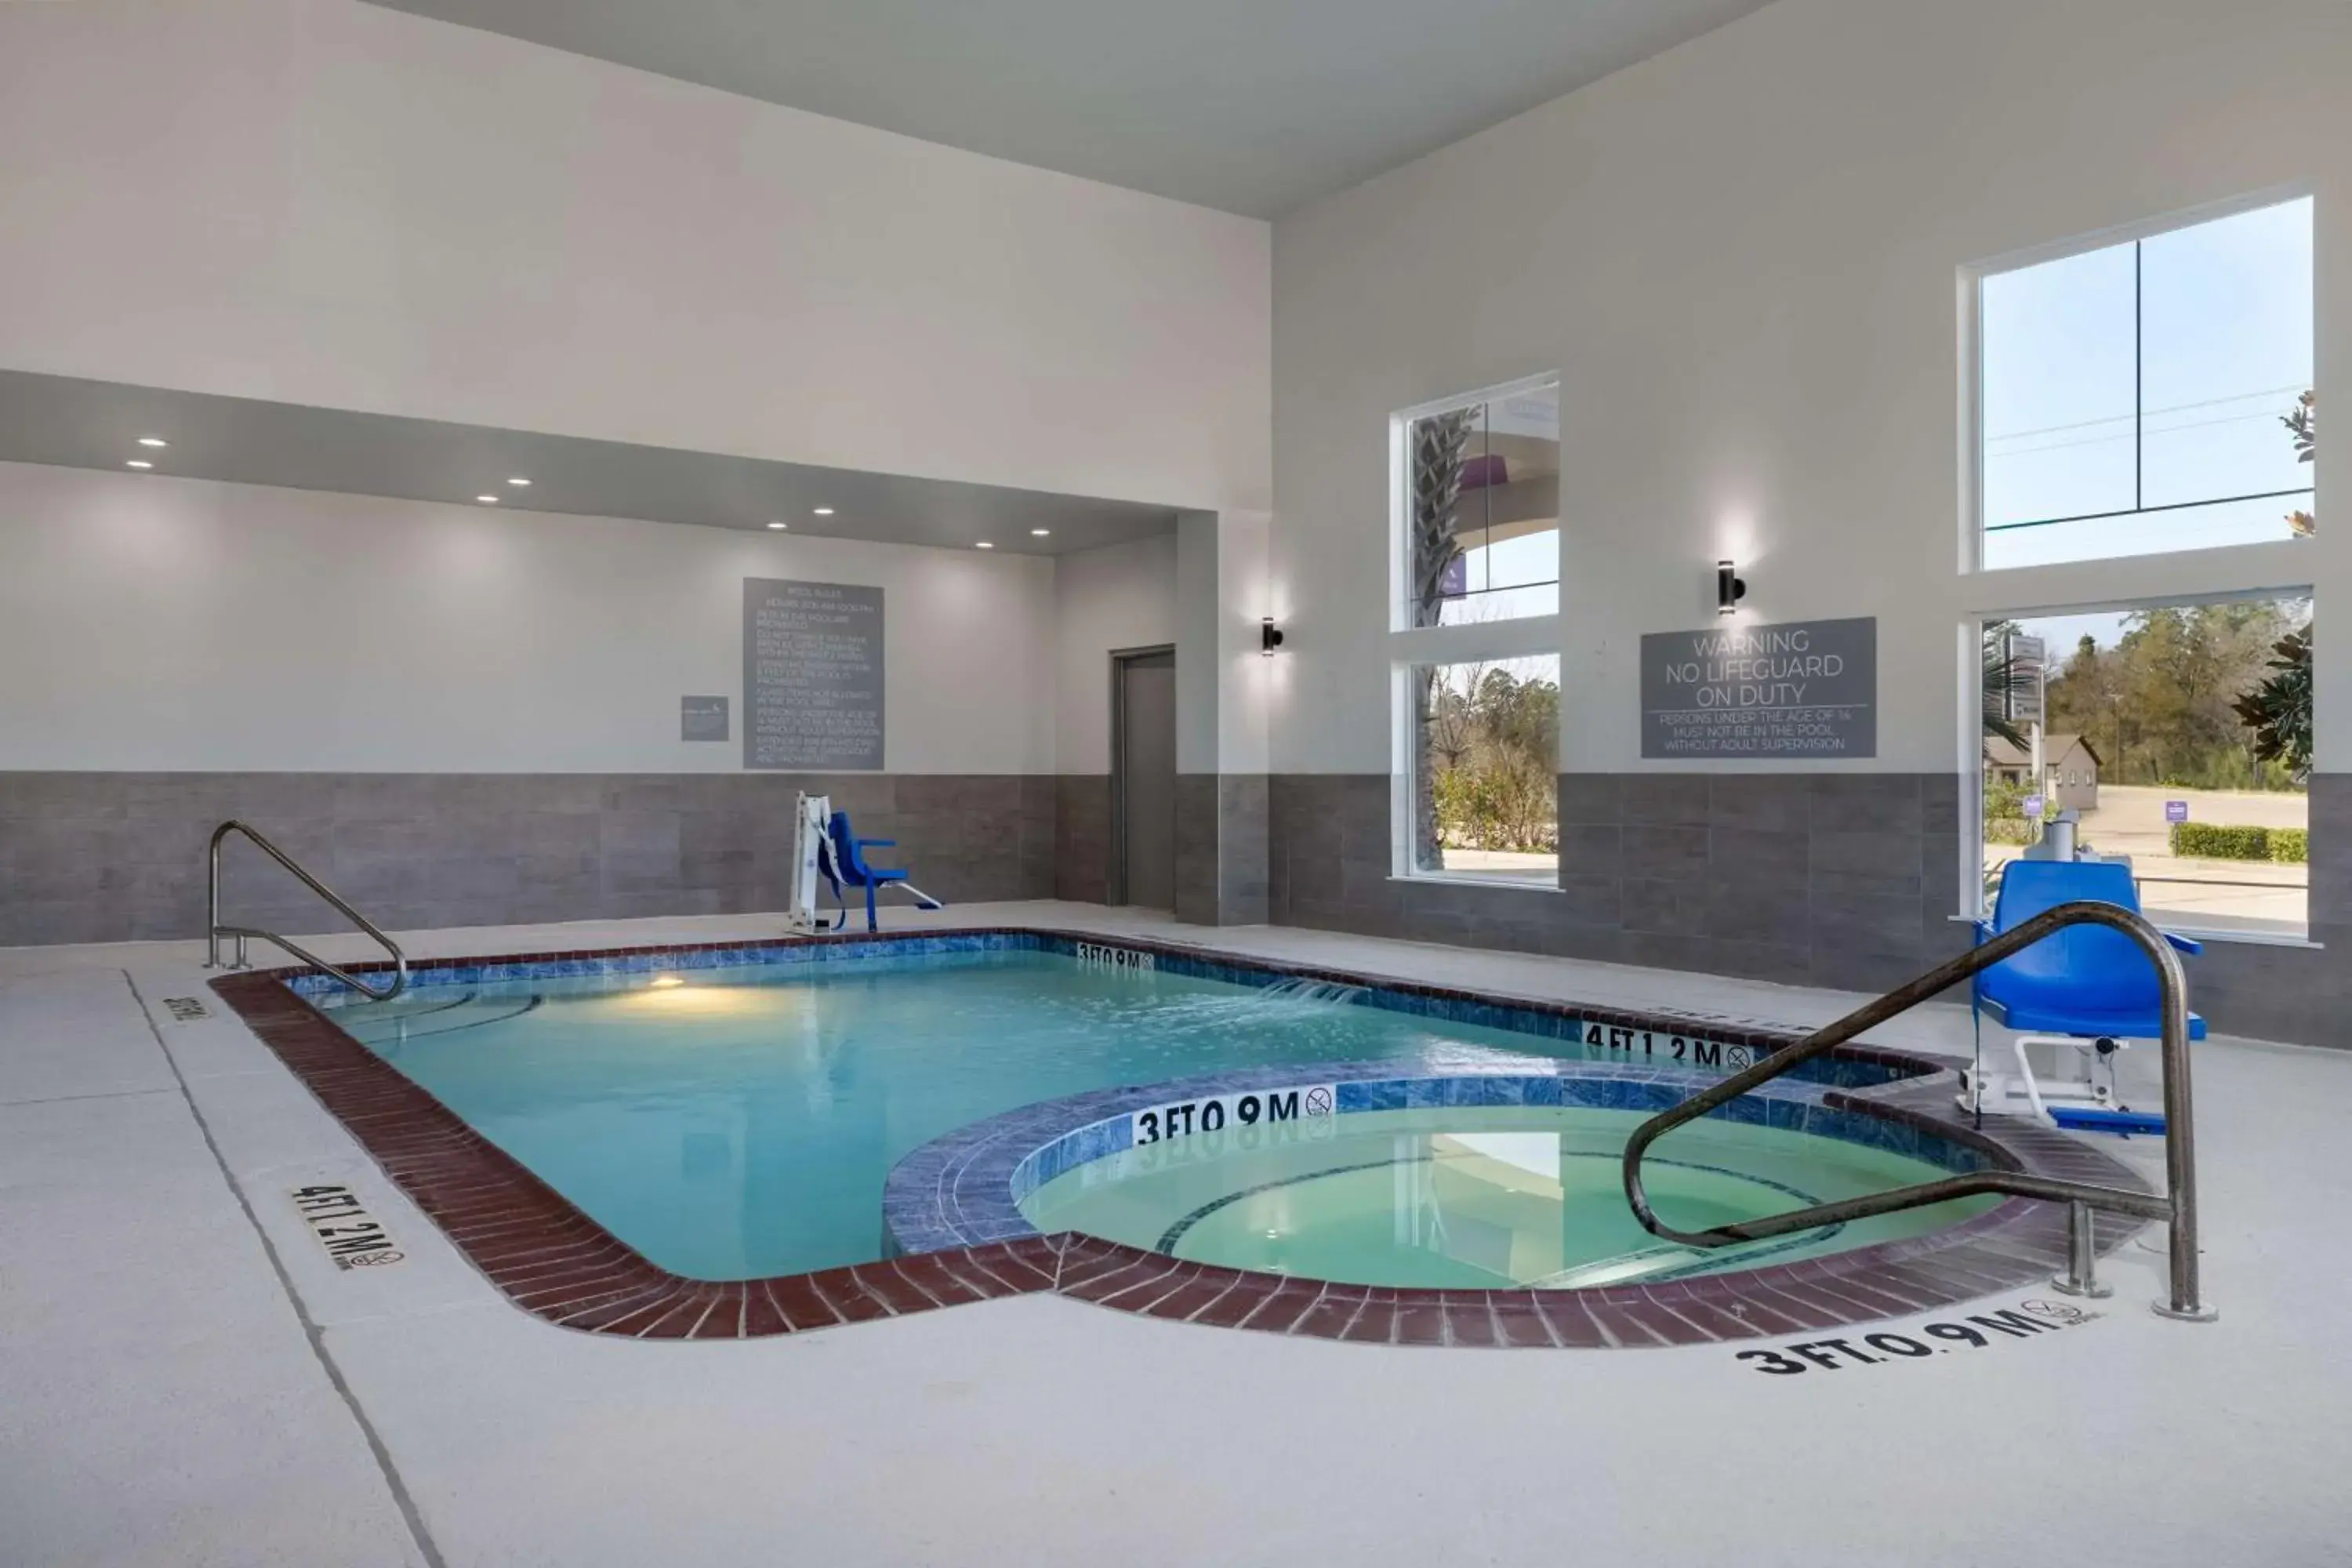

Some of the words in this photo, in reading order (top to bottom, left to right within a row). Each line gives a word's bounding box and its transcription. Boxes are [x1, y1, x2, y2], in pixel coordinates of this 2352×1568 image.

[1693, 630, 1809, 657] WARNING
[1665, 662, 1700, 684] NO
[1707, 655, 1843, 682] LIFEGUARD
[1697, 687, 1731, 707] ON
[1740, 683, 1806, 706] DUTY
[1660, 713, 1711, 726] PERSONS
[1714, 712, 1756, 724] UNDER
[1759, 710, 1783, 722] THE
[1787, 710, 1813, 721] AGE
[1817, 709, 1834, 720] OF
[1674, 726, 1703, 738] MUST
[1708, 725, 1732, 737] NOT
[1735, 724, 1751, 737] BE
[1754, 724, 1766, 736] IN
[1771, 724, 1794, 736] THE
[1664, 739, 1718, 752] WITHOUT
[1719, 739, 1758, 751] ADULT
[1762, 738, 1845, 751] SUPERVISION
